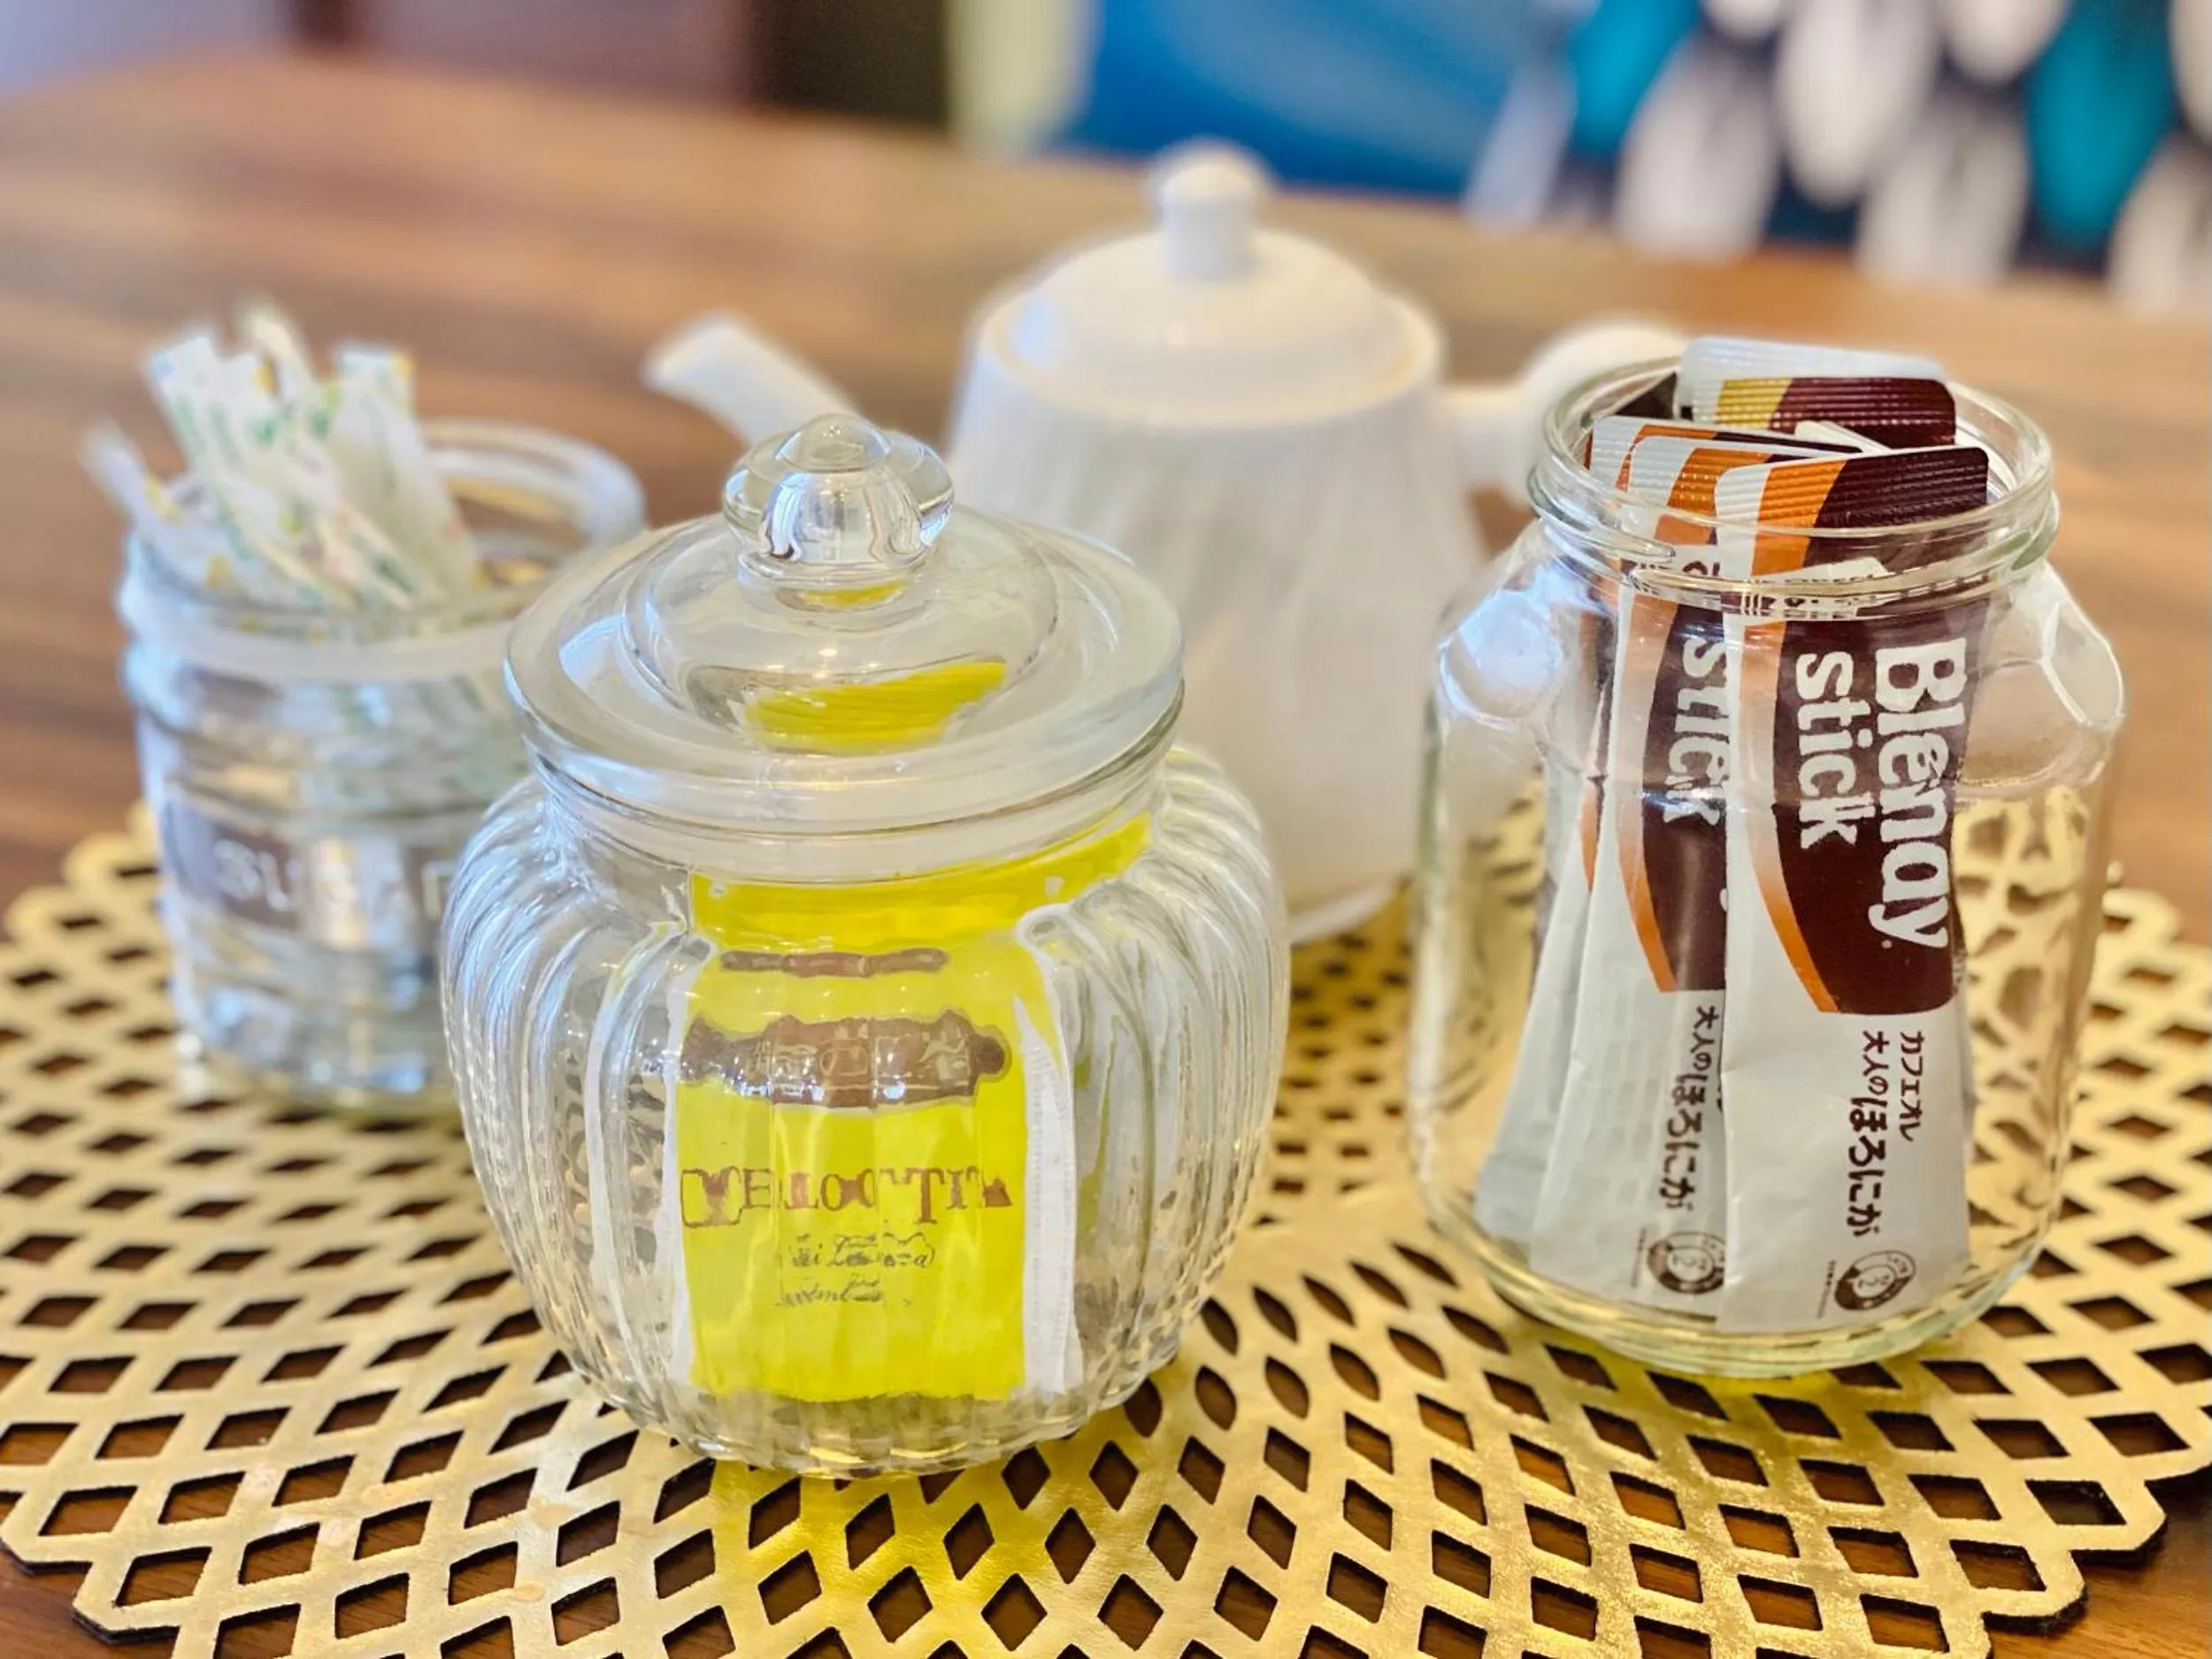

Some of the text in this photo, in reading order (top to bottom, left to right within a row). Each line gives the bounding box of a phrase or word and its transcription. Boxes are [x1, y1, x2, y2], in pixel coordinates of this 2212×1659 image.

[1795, 650, 1877, 849] stick
[1659, 1004, 1720, 1211] 大人のほろにが
[1846, 1030, 1890, 1238] 大人のほろにが
